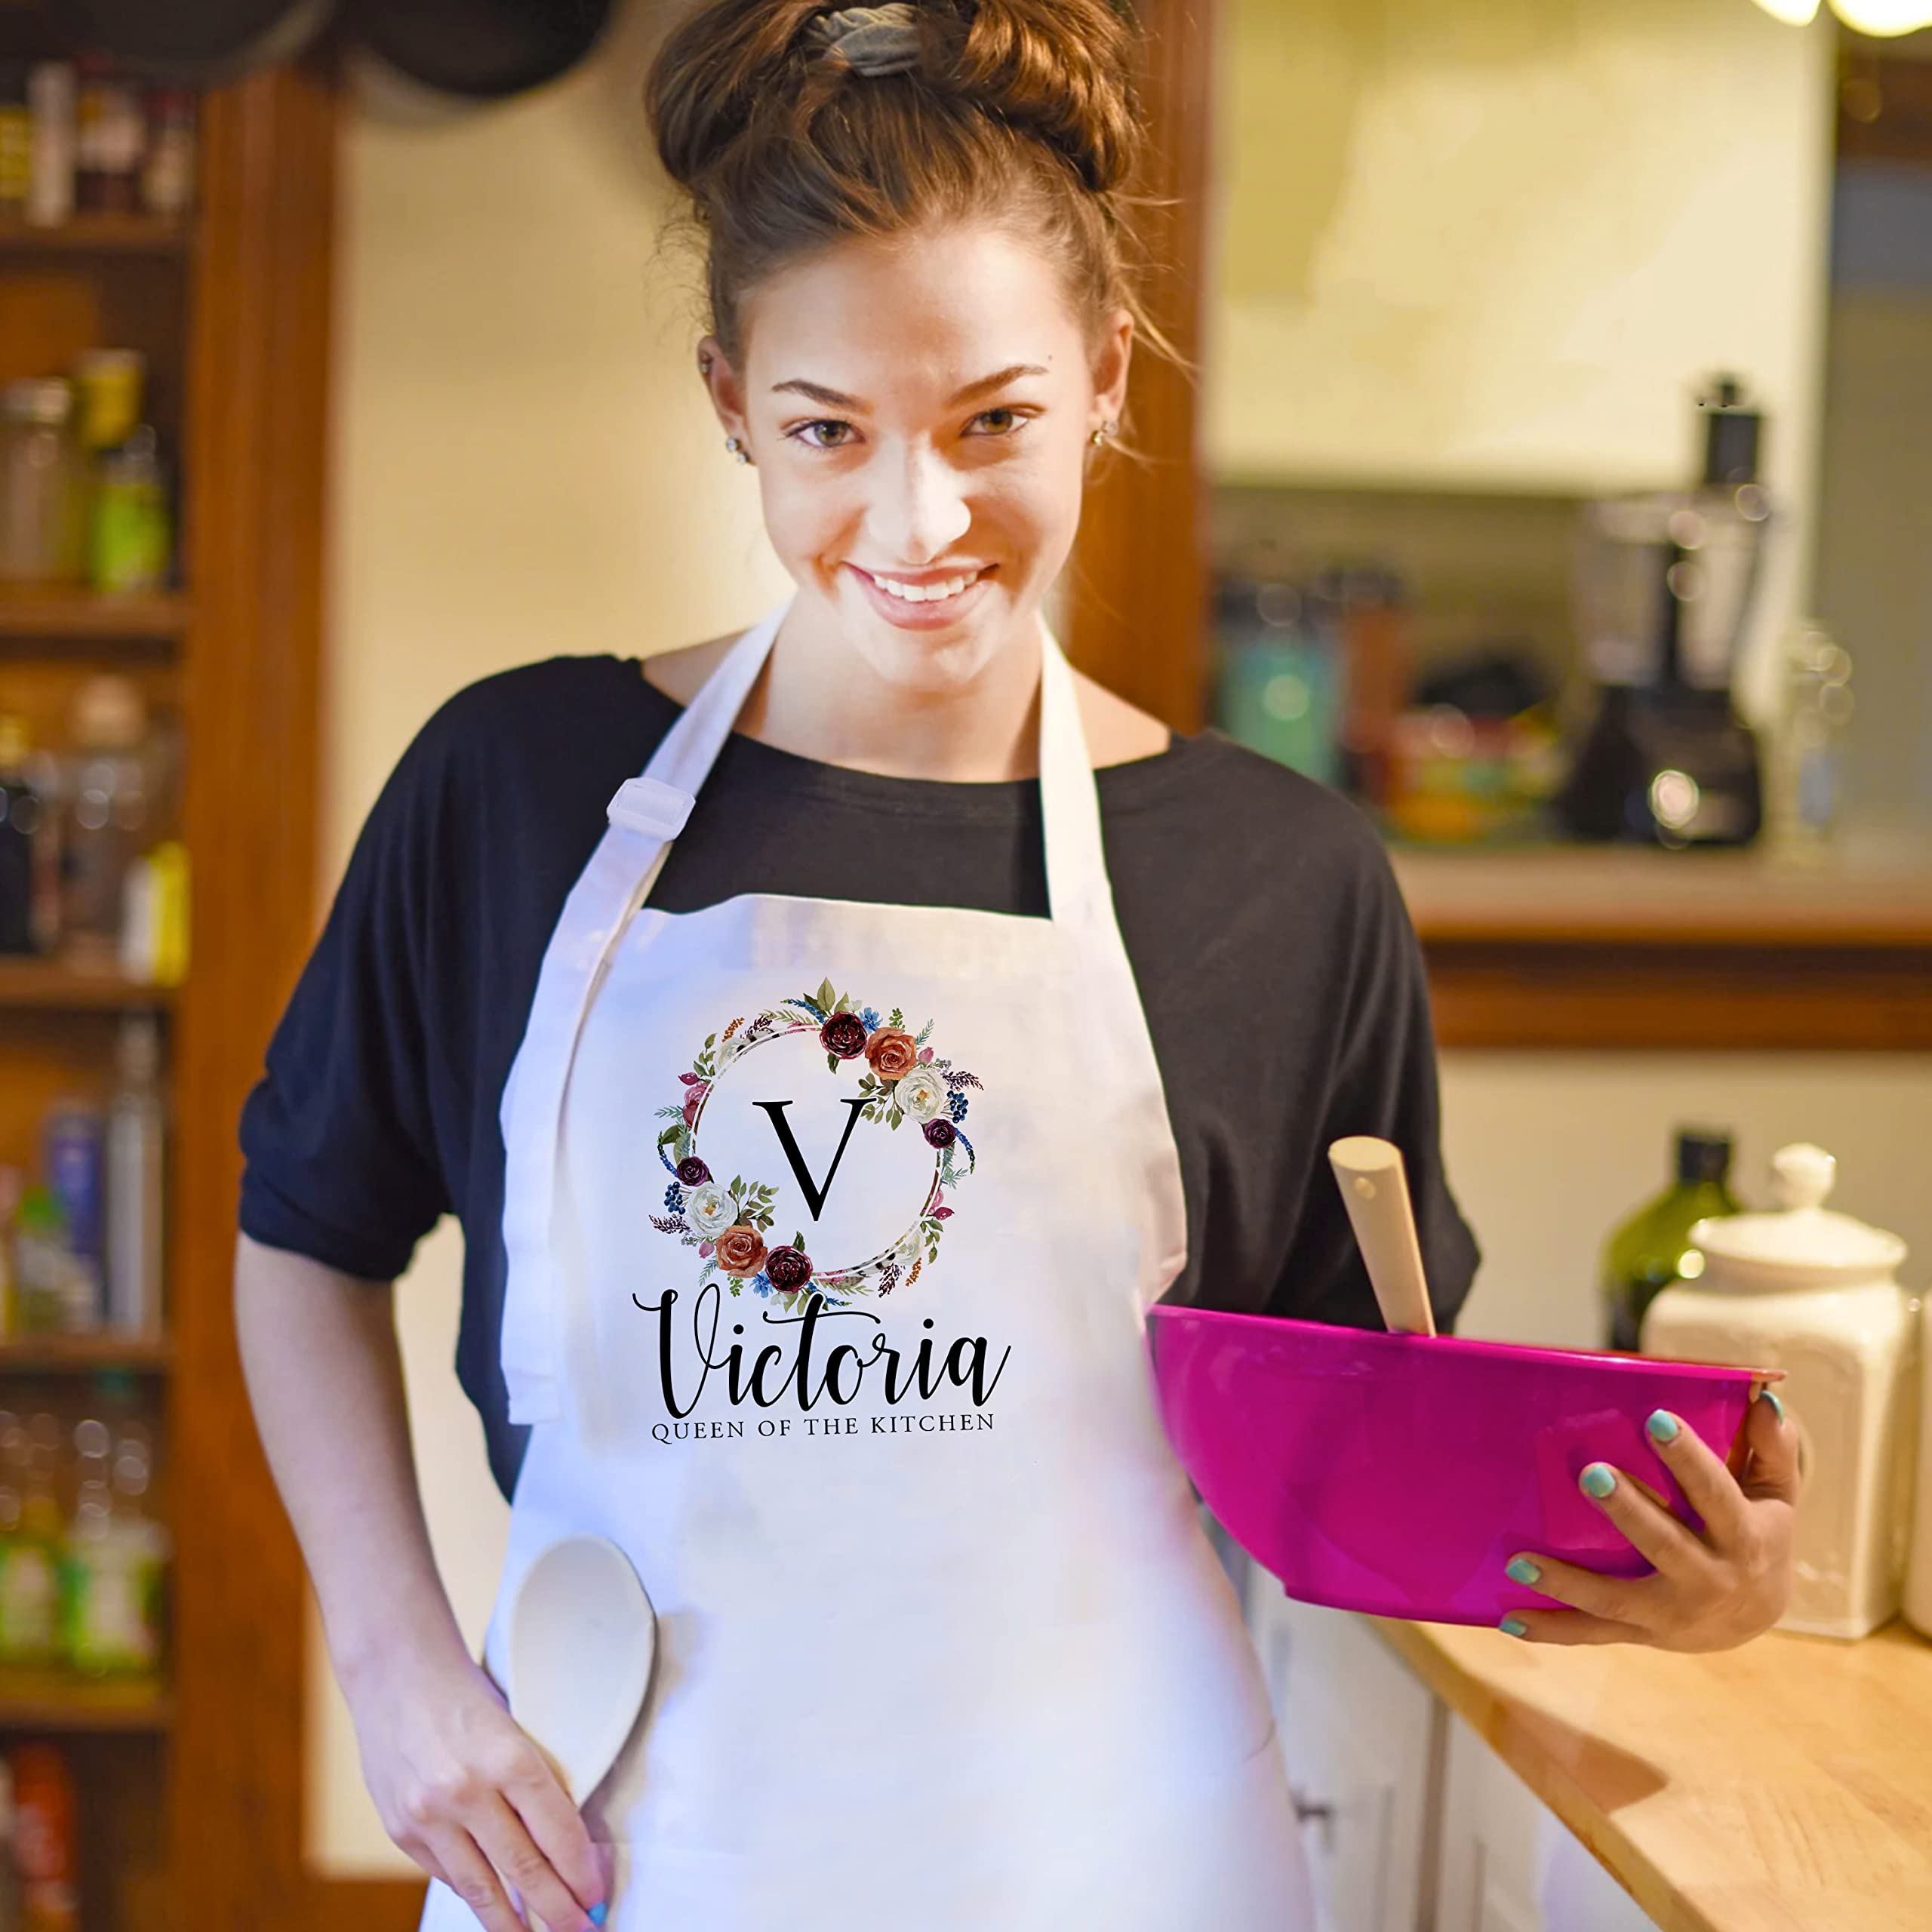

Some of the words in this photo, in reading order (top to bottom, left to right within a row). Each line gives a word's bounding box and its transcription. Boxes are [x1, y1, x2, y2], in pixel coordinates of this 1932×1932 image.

[752, 1097, 877, 1222] V
[632, 1283, 1012, 1420] Victoria
[651, 1421, 744, 1444] QUEEN
[758, 1420, 792, 1437] OF
[803, 1417, 859, 1435] THE
[870, 1414, 994, 1434] KITCHEN
